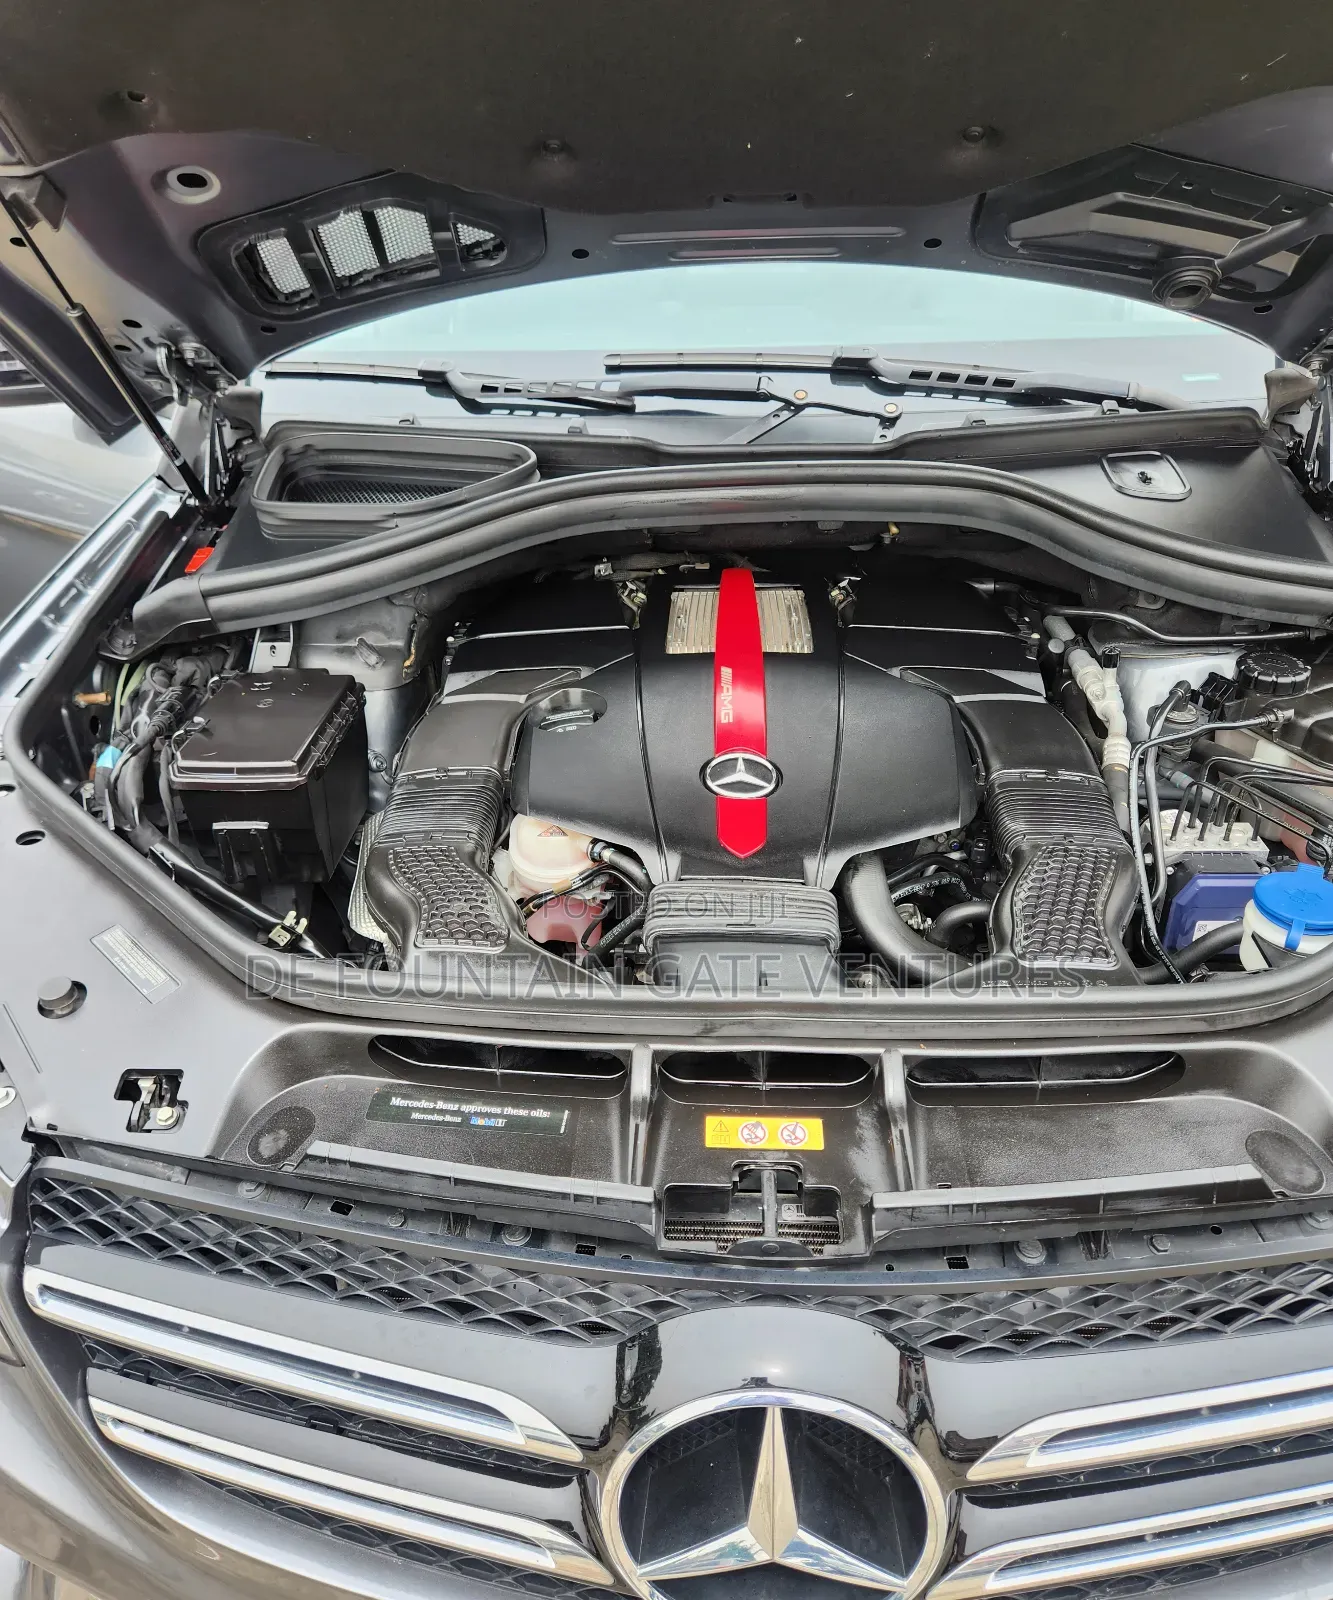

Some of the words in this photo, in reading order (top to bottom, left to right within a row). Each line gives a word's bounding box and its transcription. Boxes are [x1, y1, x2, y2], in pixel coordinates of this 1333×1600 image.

[720, 683, 733, 723] AMG
[390, 1096, 459, 1111] Mercedes-Benz
[460, 1105, 502, 1114] approves
[503, 1106, 529, 1117] these
[530, 1108, 551, 1118] oils:
[411, 1112, 462, 1123] Mercedes-Benz
